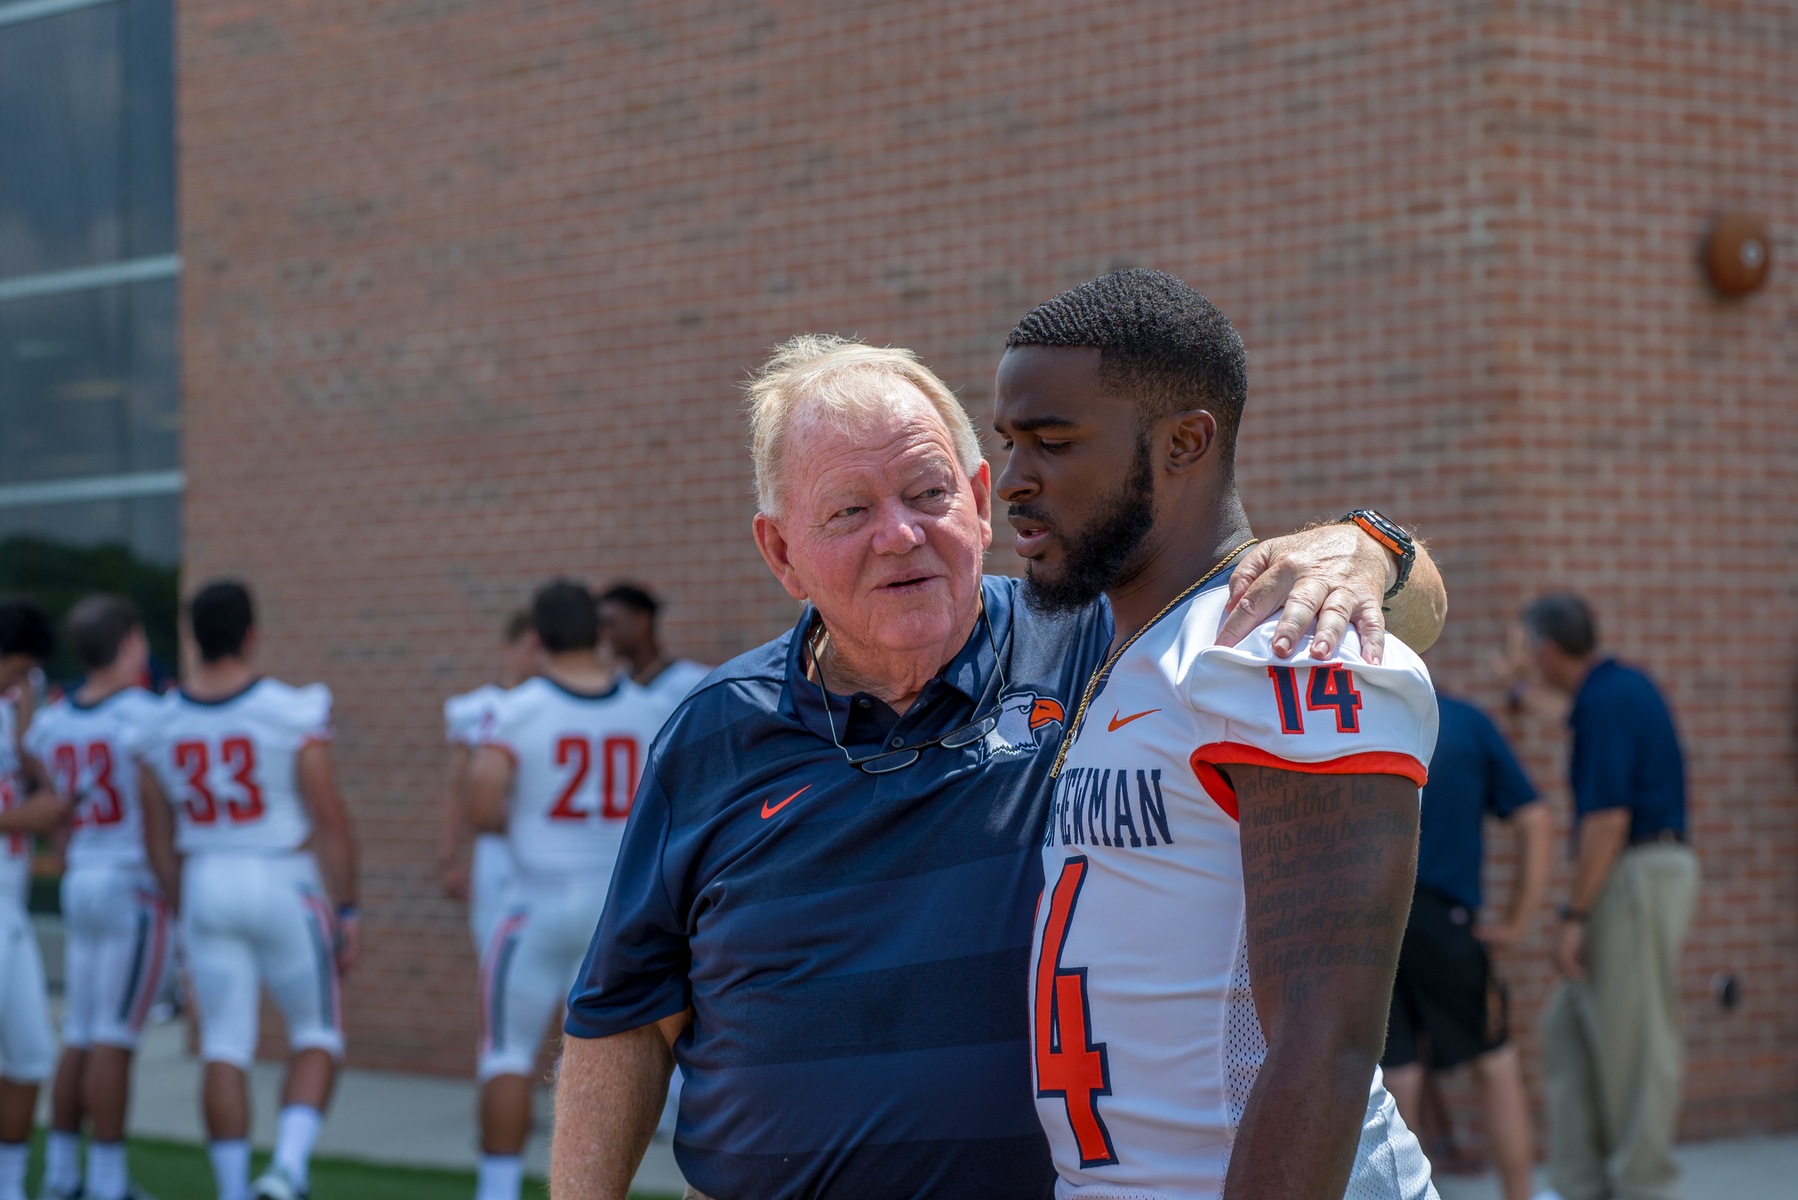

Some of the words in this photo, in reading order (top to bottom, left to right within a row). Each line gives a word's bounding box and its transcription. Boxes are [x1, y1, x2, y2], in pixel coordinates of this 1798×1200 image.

[1267, 662, 1363, 735] 14
[174, 736, 266, 824] 33
[548, 733, 640, 822] 20
